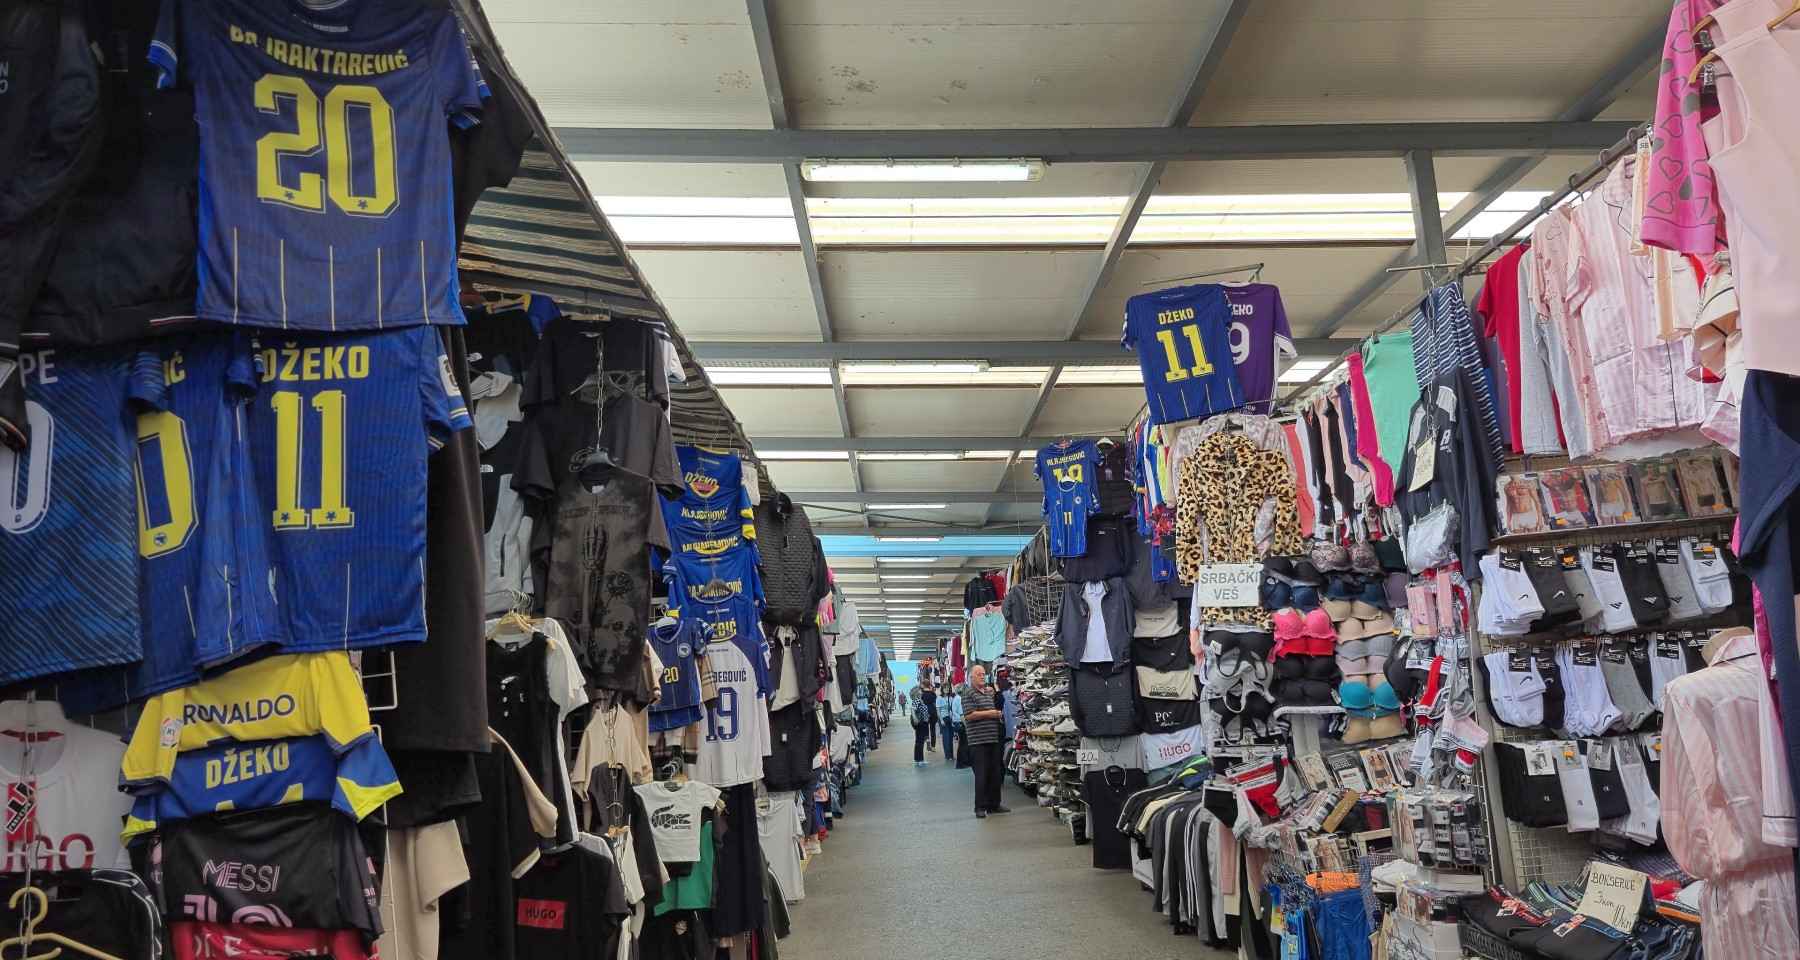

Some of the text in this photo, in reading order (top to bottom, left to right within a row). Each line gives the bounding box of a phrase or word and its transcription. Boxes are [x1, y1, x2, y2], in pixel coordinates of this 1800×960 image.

[254, 73, 400, 217] 20
[1158, 307, 1195, 325] DŽEKO
[261, 342, 370, 382] DŽEKO
[1155, 324, 1215, 383] 11
[271, 389, 355, 531] 11
[1214, 584, 1240, 601] VEŠ
[663, 665, 680, 684] 20
[183, 694, 297, 726] RONALDO
[705, 685, 740, 742] 19
[205, 742, 291, 790] DŽEKO
[202, 859, 281, 892] MESSI
